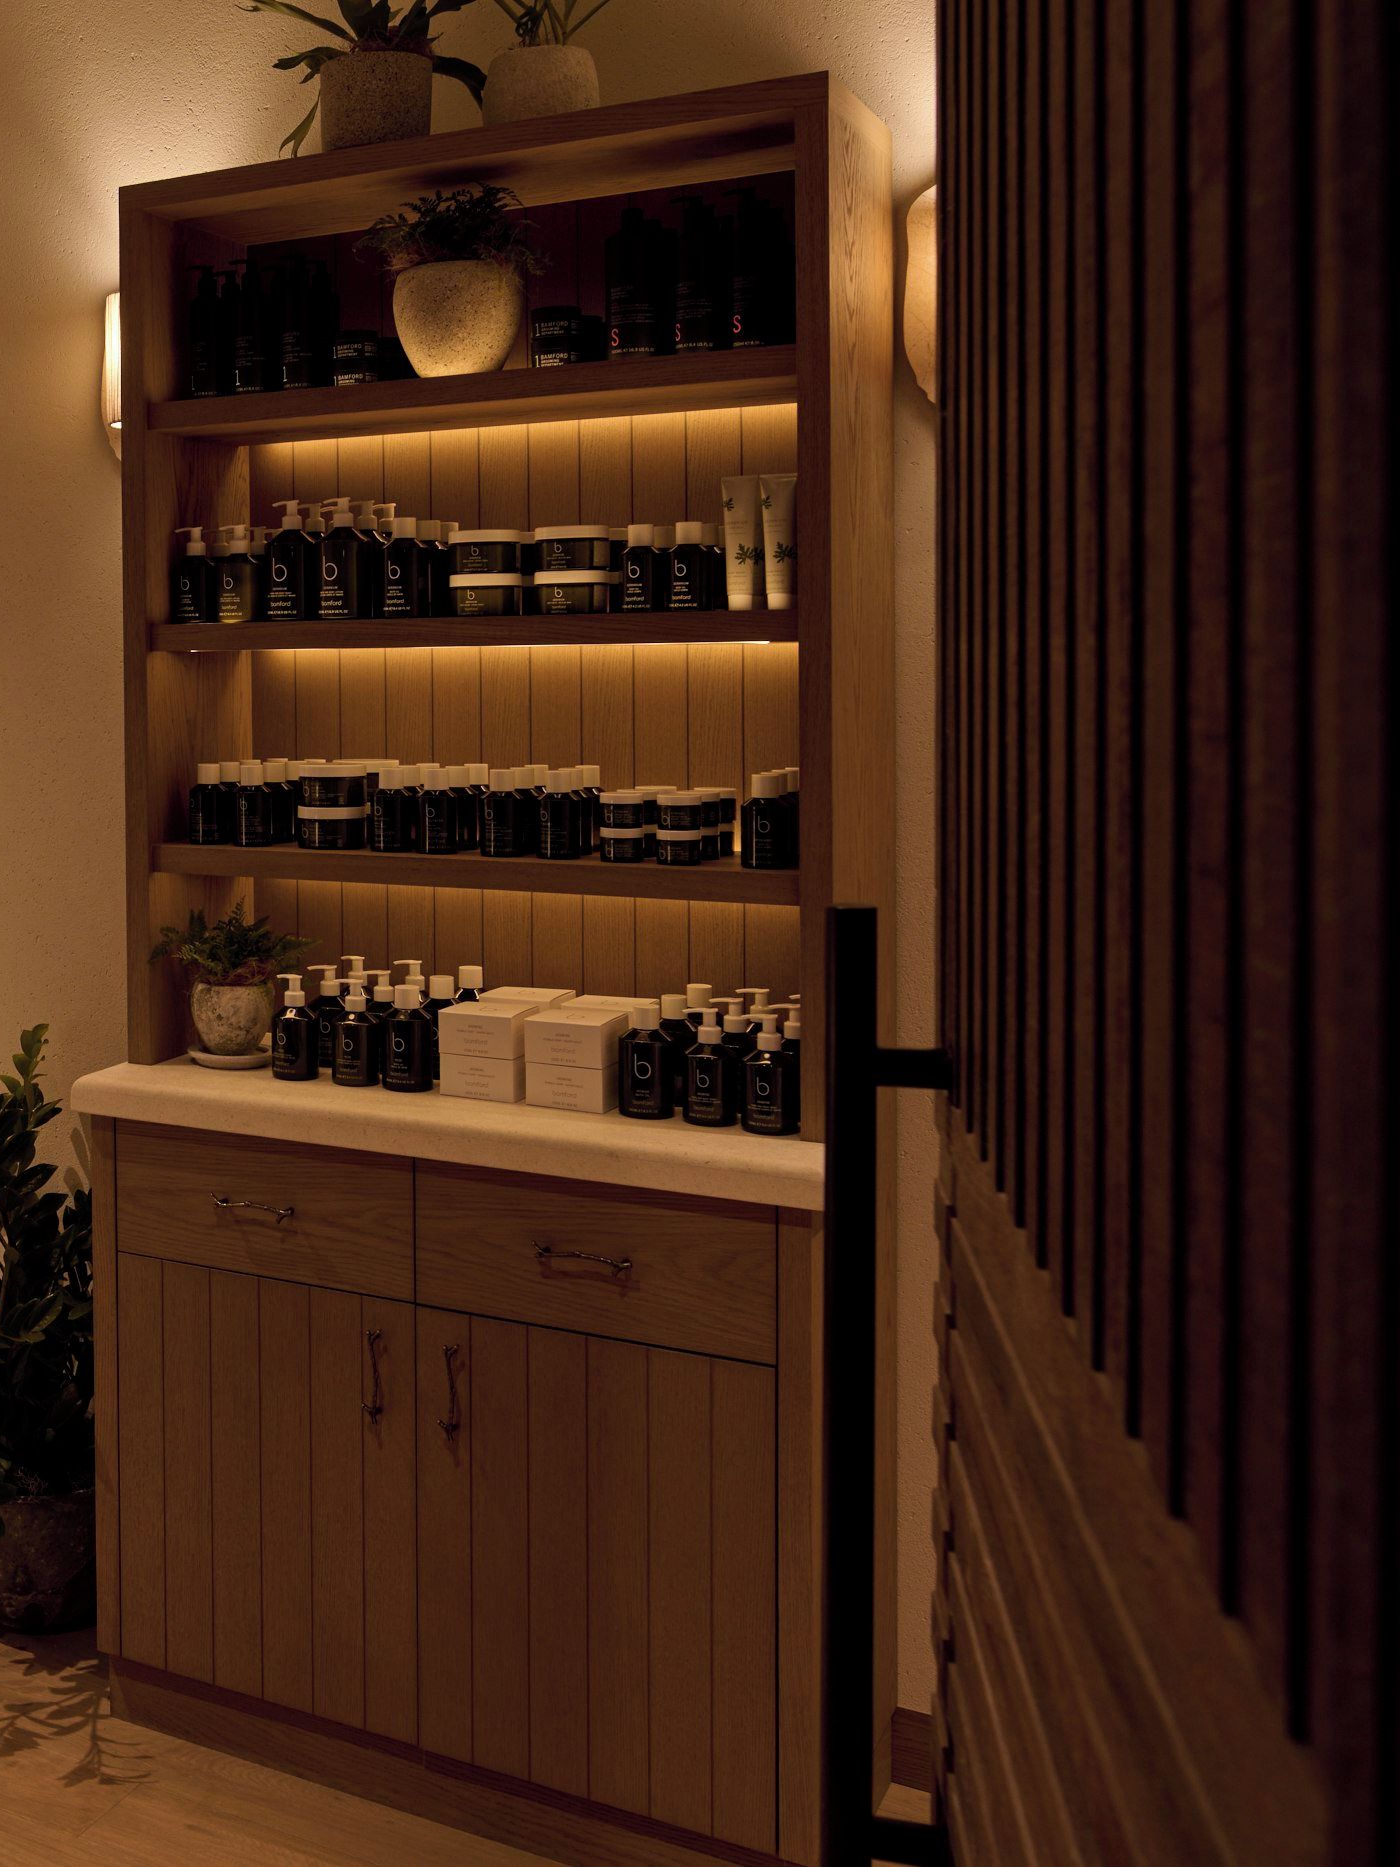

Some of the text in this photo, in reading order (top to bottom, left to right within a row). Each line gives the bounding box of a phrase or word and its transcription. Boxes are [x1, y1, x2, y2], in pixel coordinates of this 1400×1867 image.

[541, 320, 569, 328] BAMFORD
[732, 314, 742, 334] S
[611, 327, 620, 347] S
[540, 352, 569, 360] BAMFORD
[337, 372, 364, 382] BAMFORD
[272, 556, 288, 582] b
[322, 554, 338, 581] b
[387, 559, 401, 580] b
[627, 560, 640, 579] b
[674, 558, 687, 577] b
[180, 575, 190, 591] b
[223, 572, 234, 590] b
[466, 589, 475, 601] b
[554, 586, 563, 598] b
[757, 815, 771, 834] b
[319, 1016, 331, 1034] b
[276, 1026, 287, 1045] b
[342, 1033, 353, 1052] b
[392, 1031, 405, 1052] b
[633, 1052, 652, 1080] b
[696, 1068, 709, 1088] b
[756, 1075, 770, 1096] b
